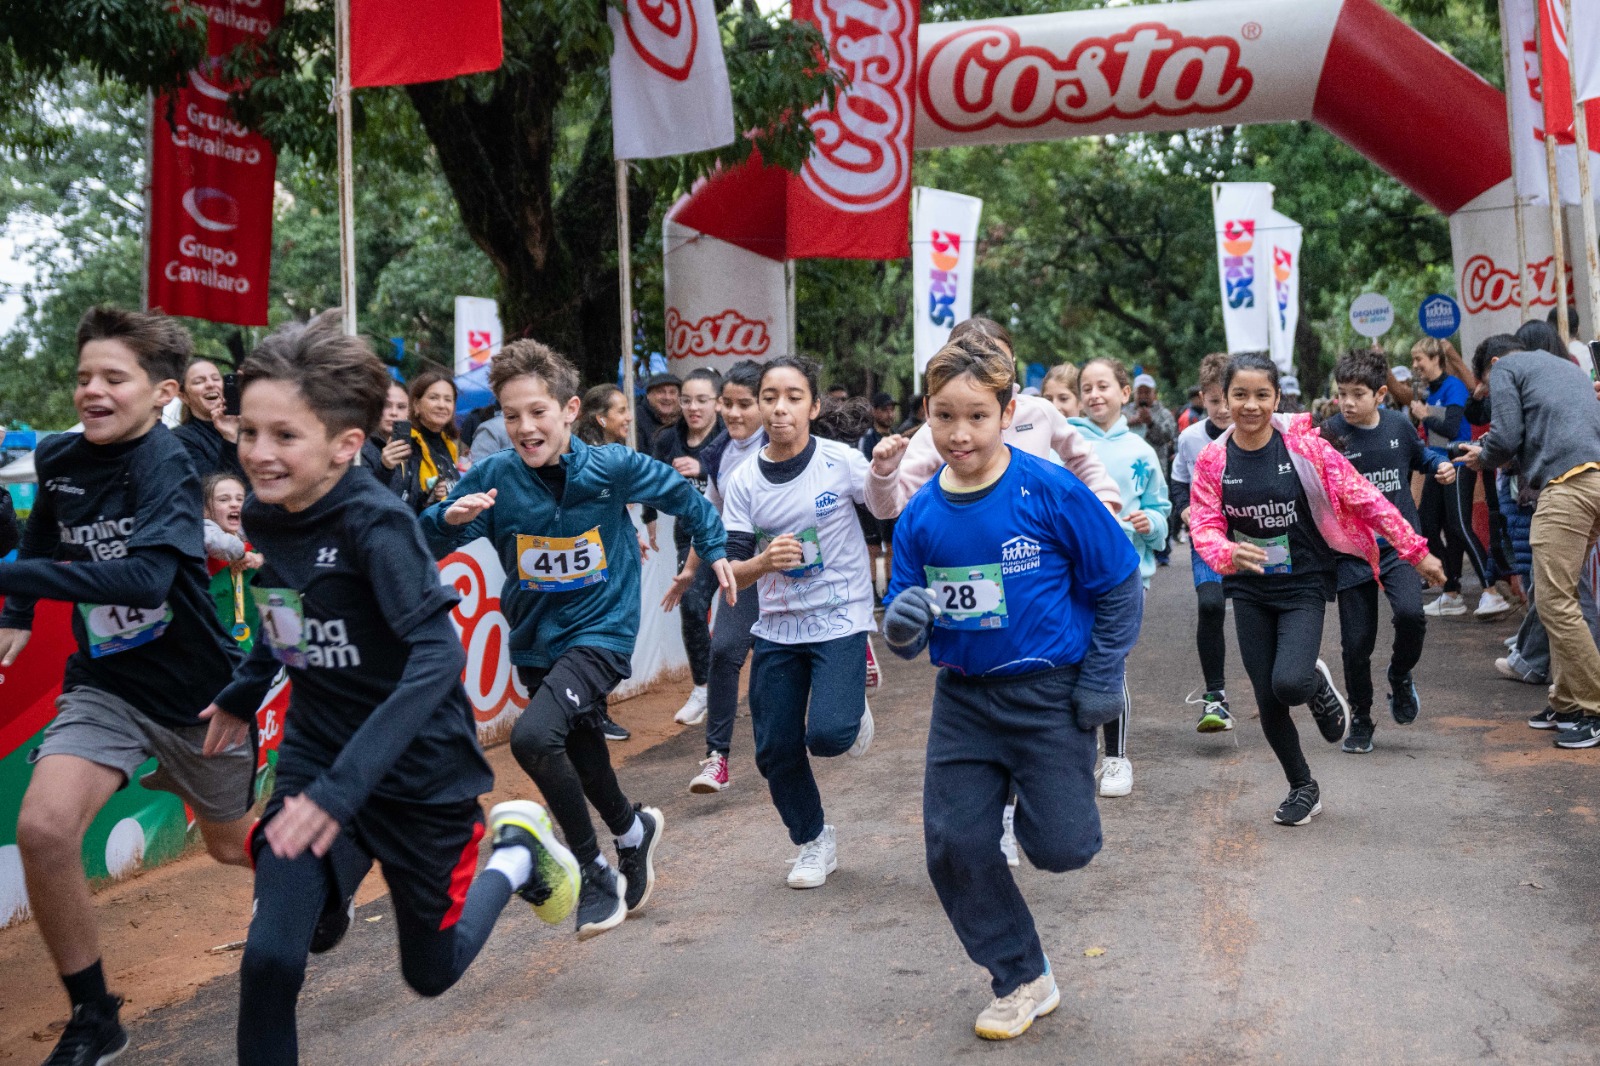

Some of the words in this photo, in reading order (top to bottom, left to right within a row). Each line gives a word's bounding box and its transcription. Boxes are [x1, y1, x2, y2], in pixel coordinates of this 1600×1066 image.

[917, 24, 1253, 132] Costa
[802, 0, 909, 211] Cost
[178, 233, 239, 268] Grupo
[164, 259, 250, 294] Cavallaro
[1462, 253, 1577, 315] Cost
[1225, 499, 1296, 518] Running
[1253, 511, 1298, 529] Team
[84, 540, 130, 562] Tea
[534, 548, 591, 574] 415
[943, 585, 977, 610] 28
[109, 605, 146, 630] 14
